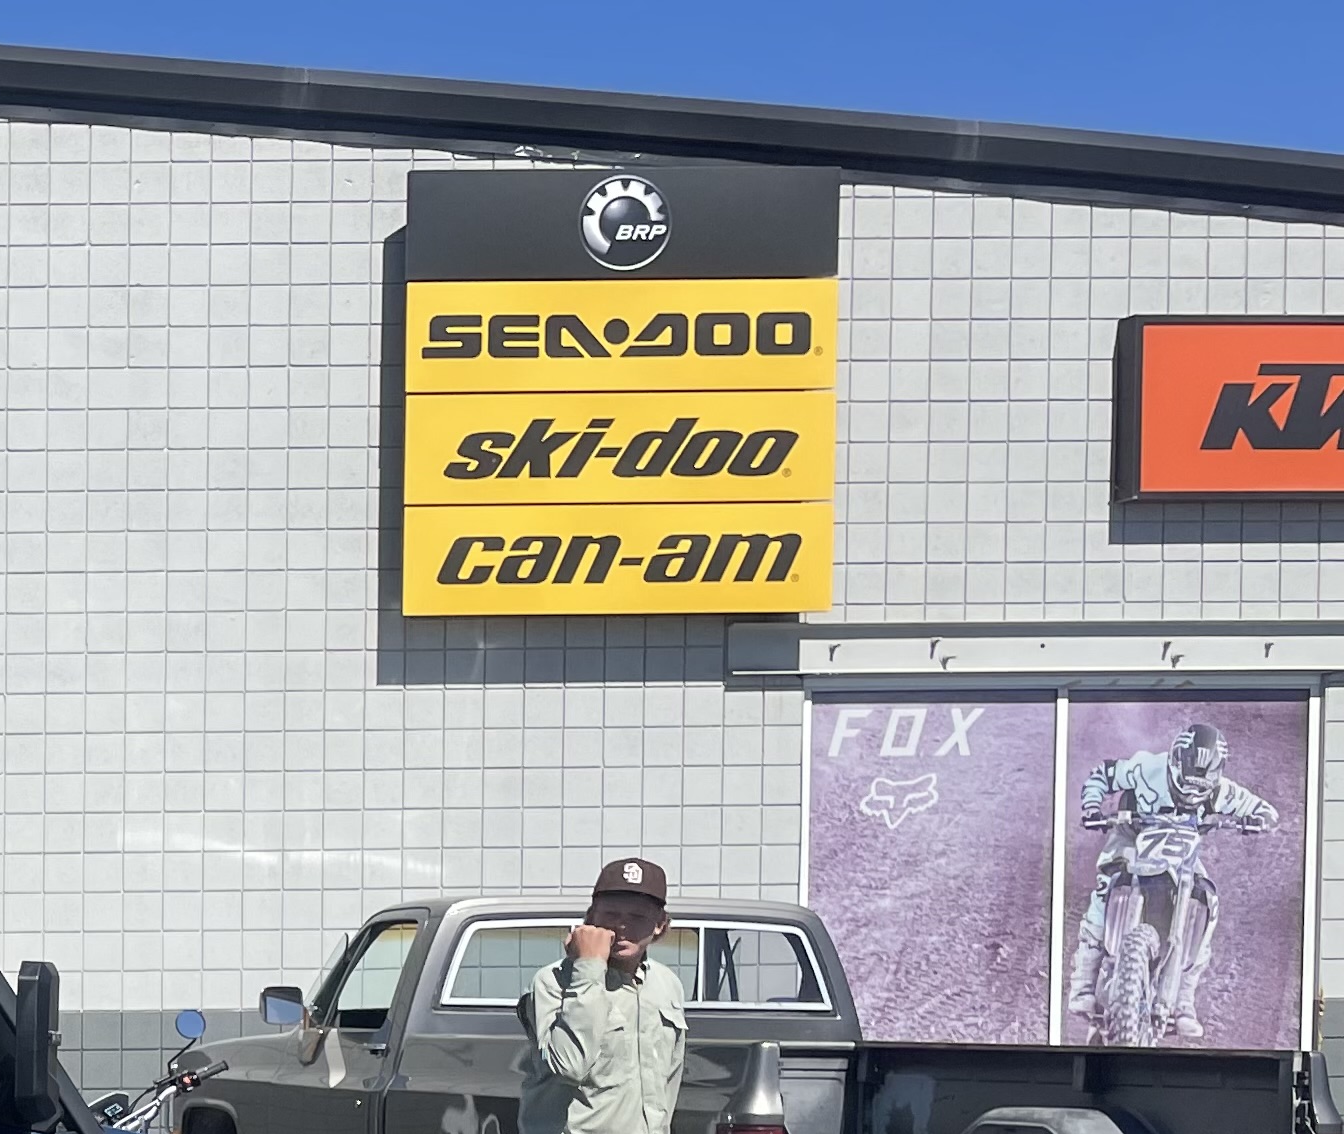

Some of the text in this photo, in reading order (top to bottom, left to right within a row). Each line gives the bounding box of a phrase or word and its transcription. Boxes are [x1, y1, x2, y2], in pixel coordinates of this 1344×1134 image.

[615, 223, 667, 242] BRP
[442, 416, 801, 480] ski-doo
[435, 532, 803, 585] can-am
[827, 707, 985, 758] FOX
